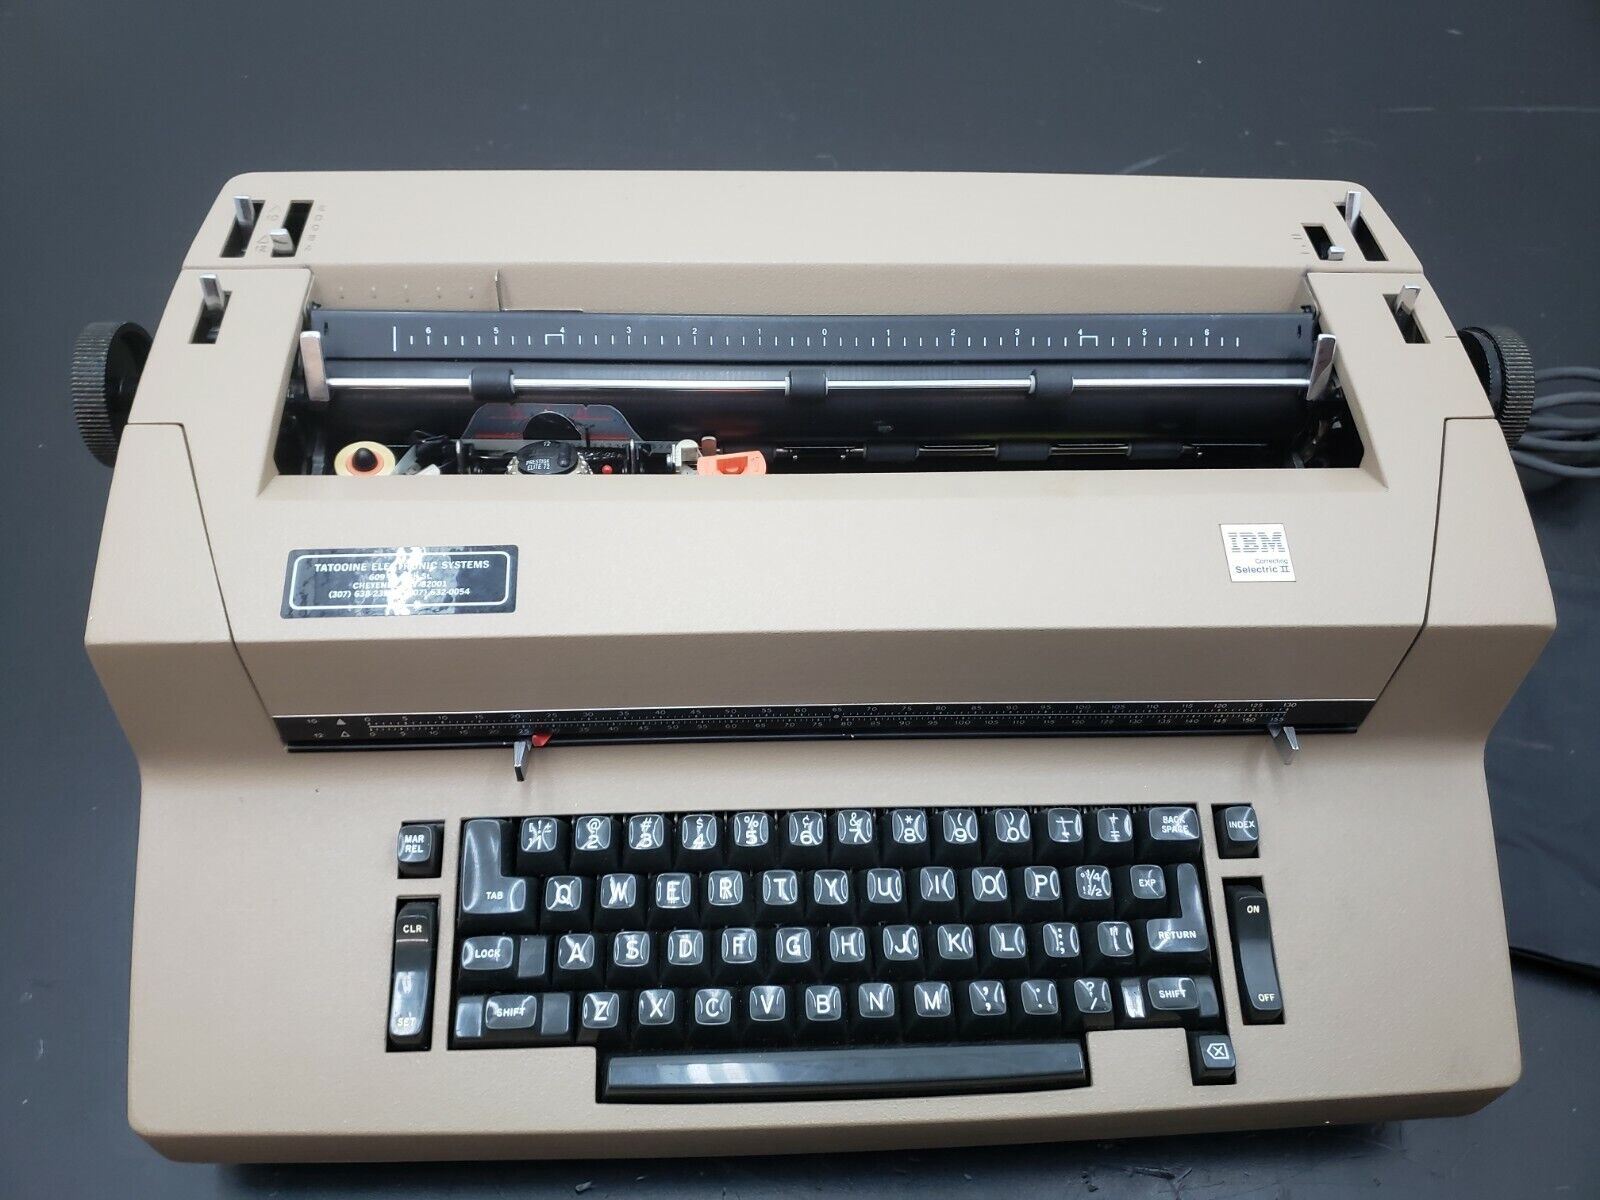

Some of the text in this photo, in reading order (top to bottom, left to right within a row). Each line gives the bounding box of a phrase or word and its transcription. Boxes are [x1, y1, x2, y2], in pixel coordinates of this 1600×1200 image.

[626, 326, 632, 334] 3
[822, 328, 828, 336] 0
[950, 328, 956, 336] 2
[1014, 328, 1020, 336] 3
[1228, 532, 1286, 552] IBM
[314, 560, 490, 573] TATOOINE ELERONIC SYSTEMS
[369, 573, 385, 581] 609
[328, 590, 351, 599] (307)
[744, 815, 759, 828] %
[1162, 815, 1185, 824] BACK
[1229, 820, 1255, 829] INDEX
[745, 830, 758, 844] 5
[800, 831, 813, 844] 6
[849, 828, 861, 843] 7
[904, 828, 916, 842] 8
[955, 828, 967, 842] 9
[1161, 825, 1189, 834] SPACE
[404, 834, 424, 844] MAR
[587, 834, 599, 848] 2
[405, 845, 424, 853] REL
[610, 880, 627, 900] W
[667, 880, 680, 901] E
[719, 877, 733, 899] R
[773, 878, 787, 898] T
[825, 878, 838, 897] Y
[878, 877, 892, 896] U
[982, 875, 997, 895] O
[1035, 874, 1048, 895] P
[1139, 878, 1156, 888] EXP
[486, 891, 503, 900] TAB
[556, 884, 572, 904] Q
[1247, 905, 1260, 914] ON
[403, 924, 422, 934] CLR
[1158, 930, 1197, 940] RETURN
[626, 940, 639, 960] S
[679, 939, 693, 958] D
[786, 936, 801, 956] G
[841, 935, 856, 956] H
[894, 934, 907, 953] J
[949, 933, 963, 952] K
[1000, 933, 1015, 952] L
[474, 949, 501, 959] LOCK
[568, 943, 586, 963] A
[869, 992, 884, 1011] N
[924, 991, 941, 1010] M
[1158, 989, 1186, 999] SHIFT
[1258, 993, 1275, 1002] OFF
[496, 1007, 526, 1017] SHIFT
[594, 1001, 608, 1021] Z
[649, 998, 664, 1018] X
[705, 998, 720, 1018] C
[760, 995, 774, 1014] V
[816, 994, 831, 1014] B
